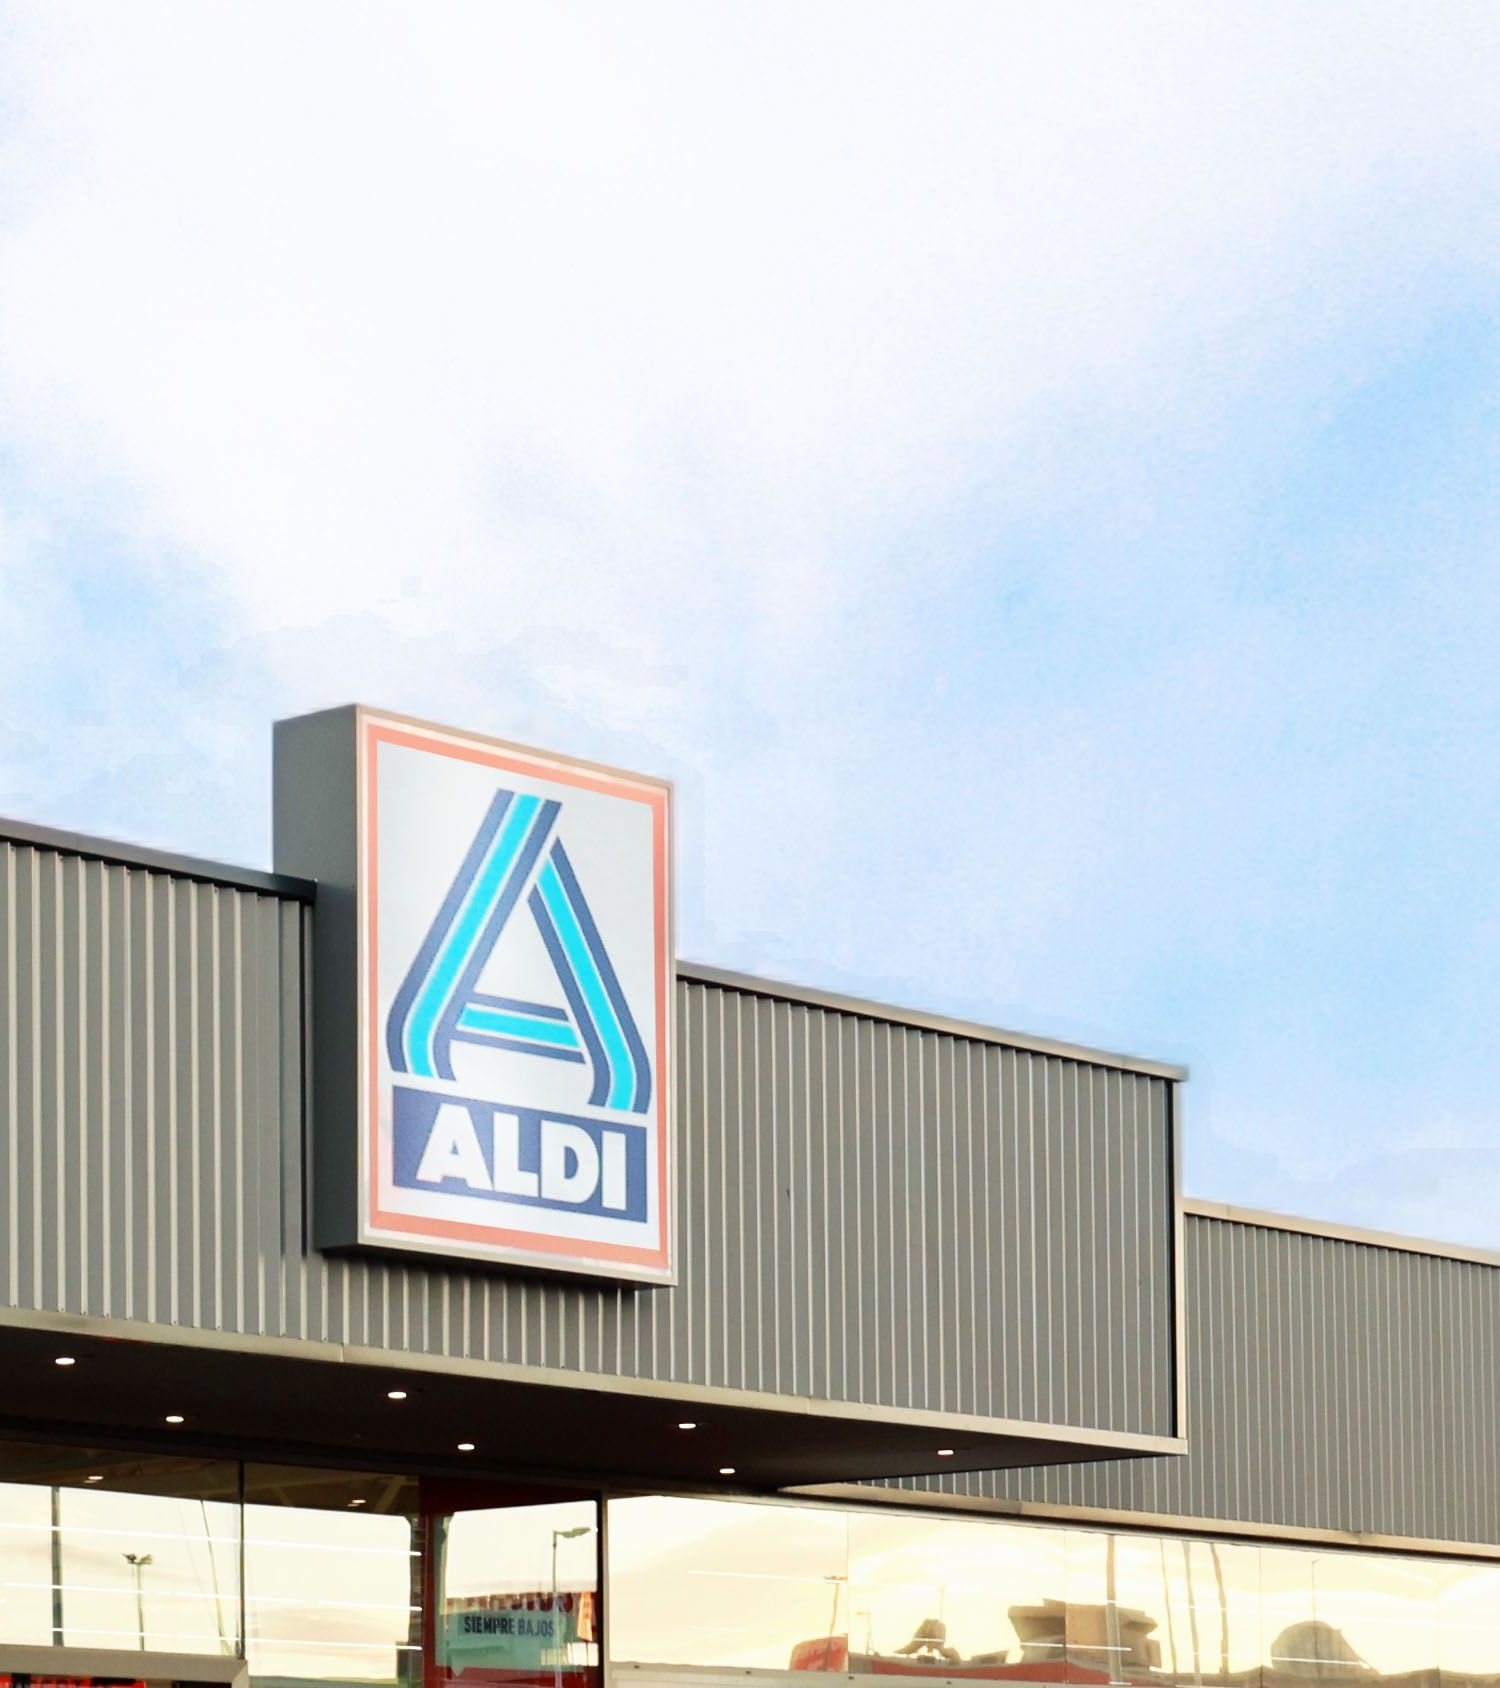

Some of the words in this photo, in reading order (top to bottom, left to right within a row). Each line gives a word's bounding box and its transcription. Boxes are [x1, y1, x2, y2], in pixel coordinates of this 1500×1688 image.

[416, 1102, 627, 1211] ALDI
[464, 1615, 515, 1634] SIEMPRE
[518, 1618, 555, 1637] BAJOS
